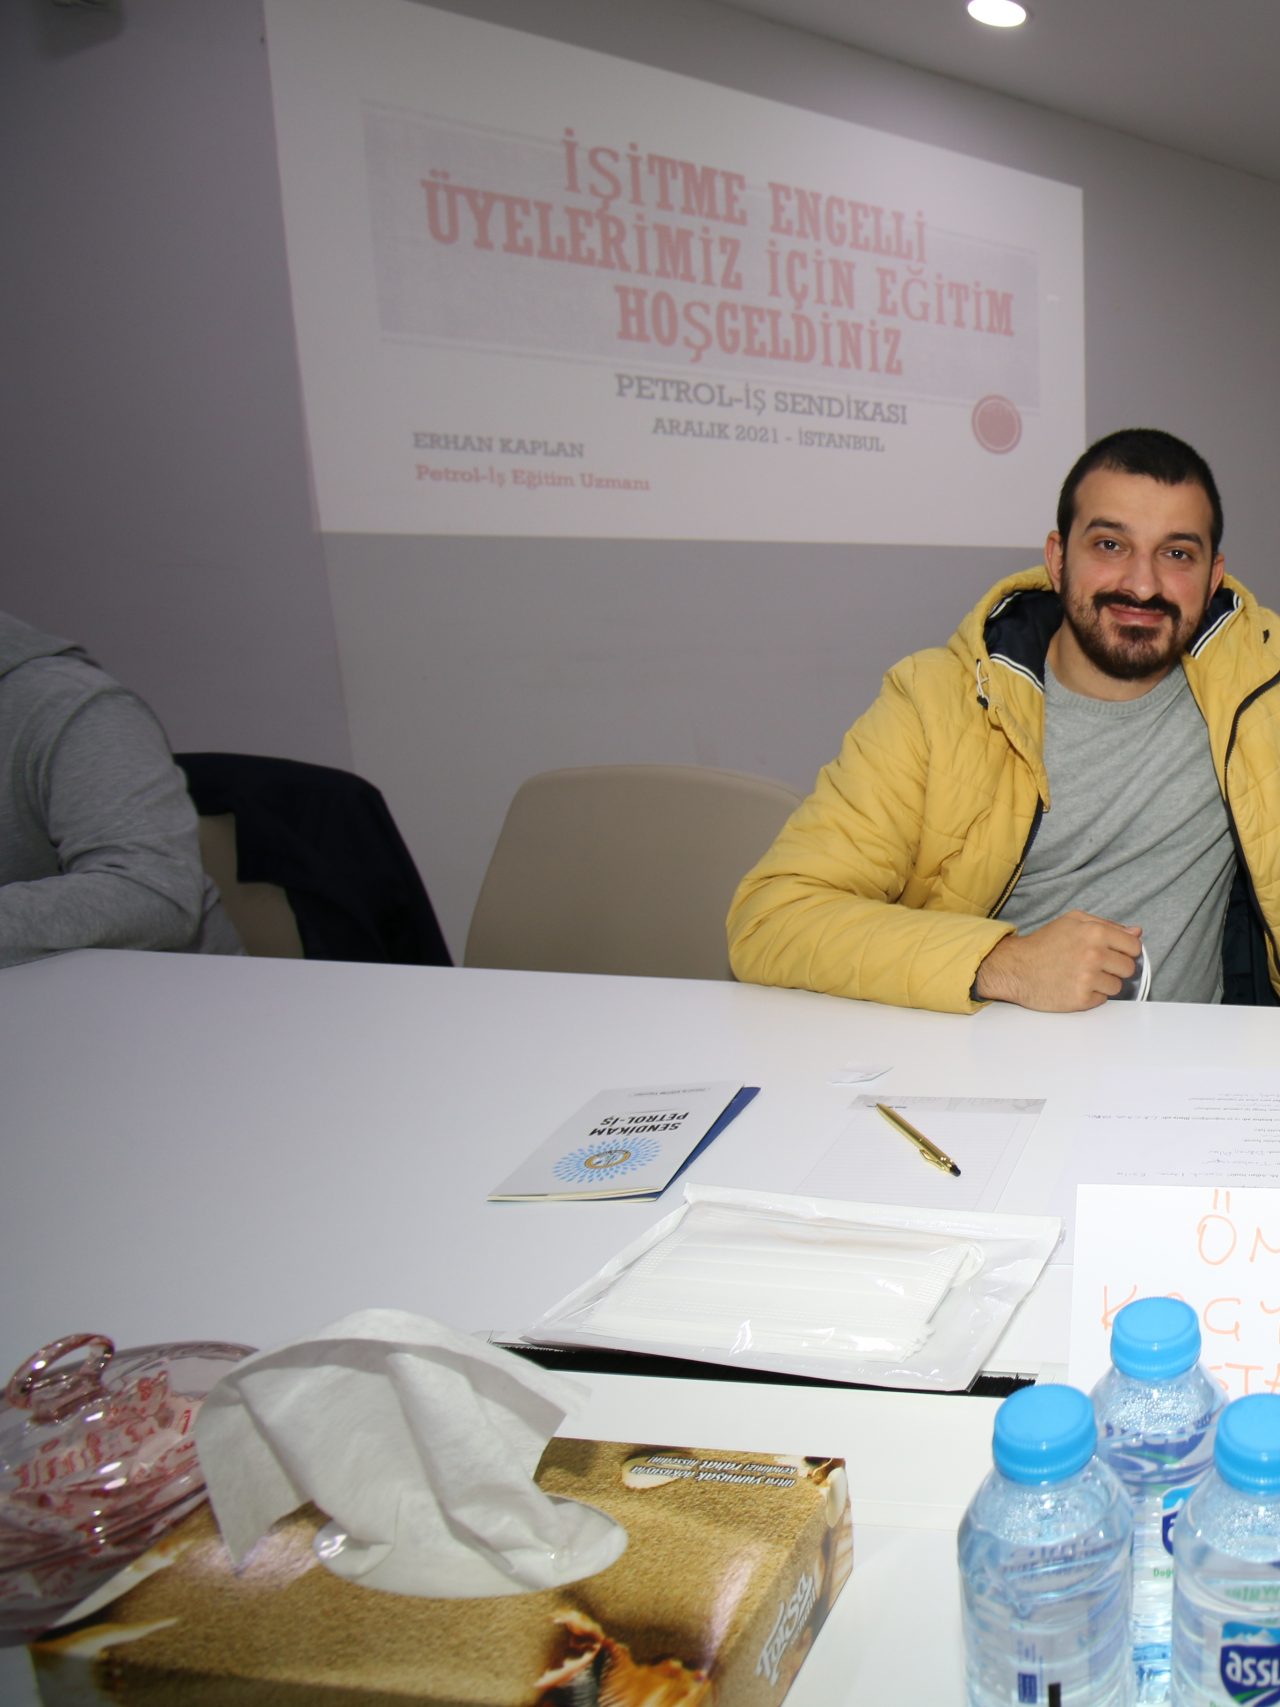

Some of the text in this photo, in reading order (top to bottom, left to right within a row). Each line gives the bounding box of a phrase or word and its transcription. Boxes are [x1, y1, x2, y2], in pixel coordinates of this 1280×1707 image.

[561, 127, 927, 264] İŞİTME ENGELLİ
[420, 168, 1015, 337] ÜYELERİMİZ İÇİN EĞİTİM
[614, 284, 904, 376] HOŞGELDİNİZ
[614, 372, 908, 425] PETROL-İŞ SENDİKASI
[412, 431, 586, 459] ERHAN KAPLAN
[652, 416, 730, 441] ARALIK
[735, 425, 779, 445] 2021
[797, 429, 886, 453] İSTANBUL
[415, 463, 651, 491] Petrol-İş Eğitim Uzmanı
[588, 1121, 682, 1137] SENDİKAM
[600, 1111, 690, 1127] PETROL-İŞ
[695, 1471, 764, 1485] yumuşak
[699, 1459, 743, 1471] rahat
